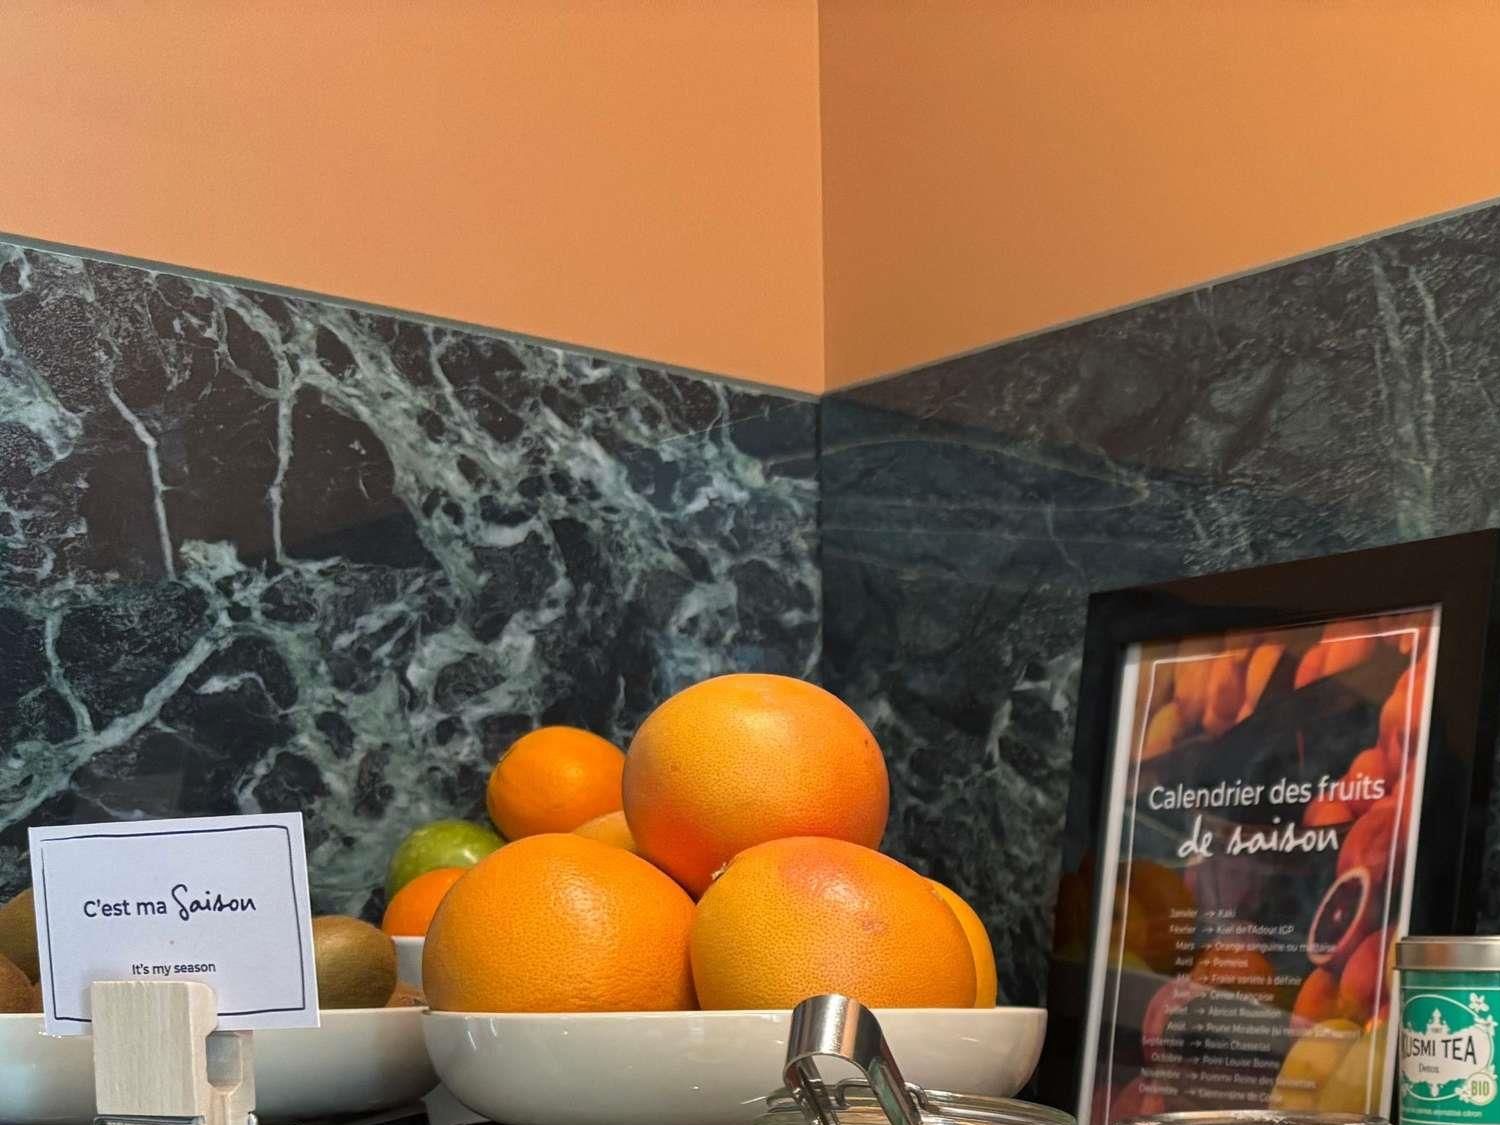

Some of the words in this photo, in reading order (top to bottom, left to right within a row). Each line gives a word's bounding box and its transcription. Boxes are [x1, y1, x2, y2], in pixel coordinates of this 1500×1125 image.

[1150, 778, 1267, 811] Calendrier
[1271, 777, 1312, 805] des
[1318, 772, 1386, 802] fruits
[1177, 816, 1214, 859] de
[1226, 817, 1339, 857] saison
[83, 899, 131, 919] C'est
[137, 902, 167, 917] ma
[171, 884, 256, 921] Saison
[132, 963, 150, 975] It's
[152, 965, 172, 977] my
[174, 962, 216, 974] season
[1441, 1035, 1477, 1065] TEA
[1471, 1080, 1490, 1096] BIO
